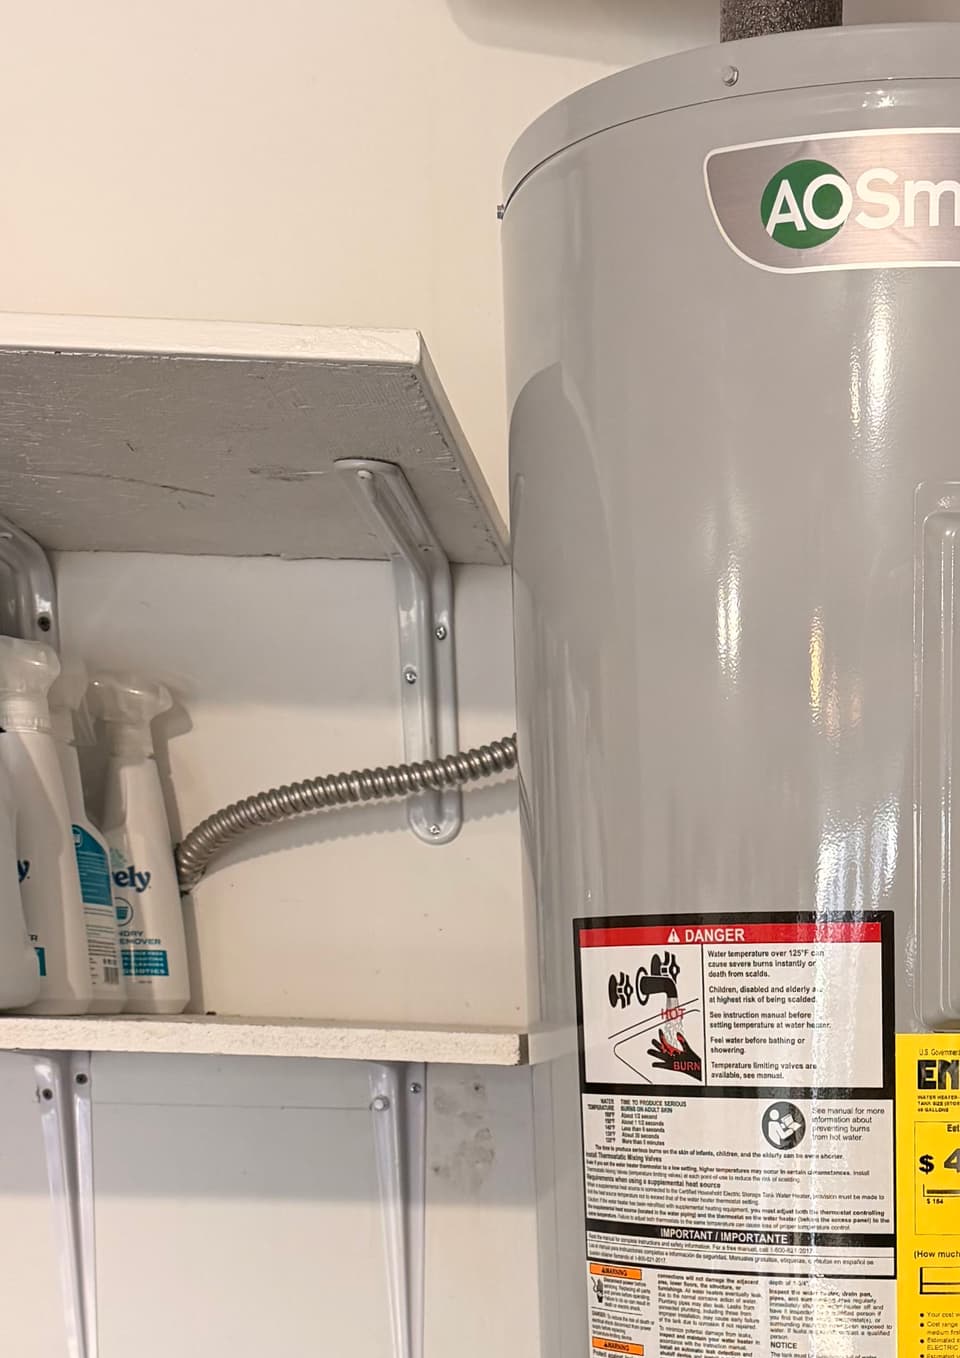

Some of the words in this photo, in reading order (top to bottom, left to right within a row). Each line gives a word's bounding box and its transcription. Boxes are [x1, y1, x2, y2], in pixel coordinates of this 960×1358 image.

[685, 928, 745, 943] DANGER
[728, 950, 769, 959] temperature
[774, 960, 806, 968] instantly
[708, 970, 727, 978] death
[739, 985, 769, 993] disabled
[770, 985, 784, 993] and
[785, 985, 810, 994] elderly
[716, 995, 741, 1004] highest
[742, 995, 755, 1003] risk
[757, 995, 765, 1003] of
[766, 995, 786, 1004] being
[661, 1008, 686, 1020] HOT
[709, 1011, 721, 1019] See
[722, 1011, 760, 1019] instruction
[788, 1011, 812, 1019] before
[710, 1022, 732, 1030] setting
[733, 1022, 775, 1030] temperature
[710, 1036, 724, 1044] Feel
[745, 1036, 767, 1044] before
[768, 1036, 795, 1045] bathing
[673, 1061, 701, 1071] BURN
[711, 1061, 752, 1069] Temperature
[753, 1062, 779, 1070] limiting
[852, 1116, 872, 1124] about
[850, 1125, 870, 1133] burns
[918, 1154, 935, 1175] $
[660, 1228, 712, 1241] IMPORTANT
[720, 1231, 788, 1244] IMPORTANTE
[913, 1250, 935, 1259] (How
[938, 1250, 960, 1259] much
[770, 1341, 798, 1349] NOTICE
